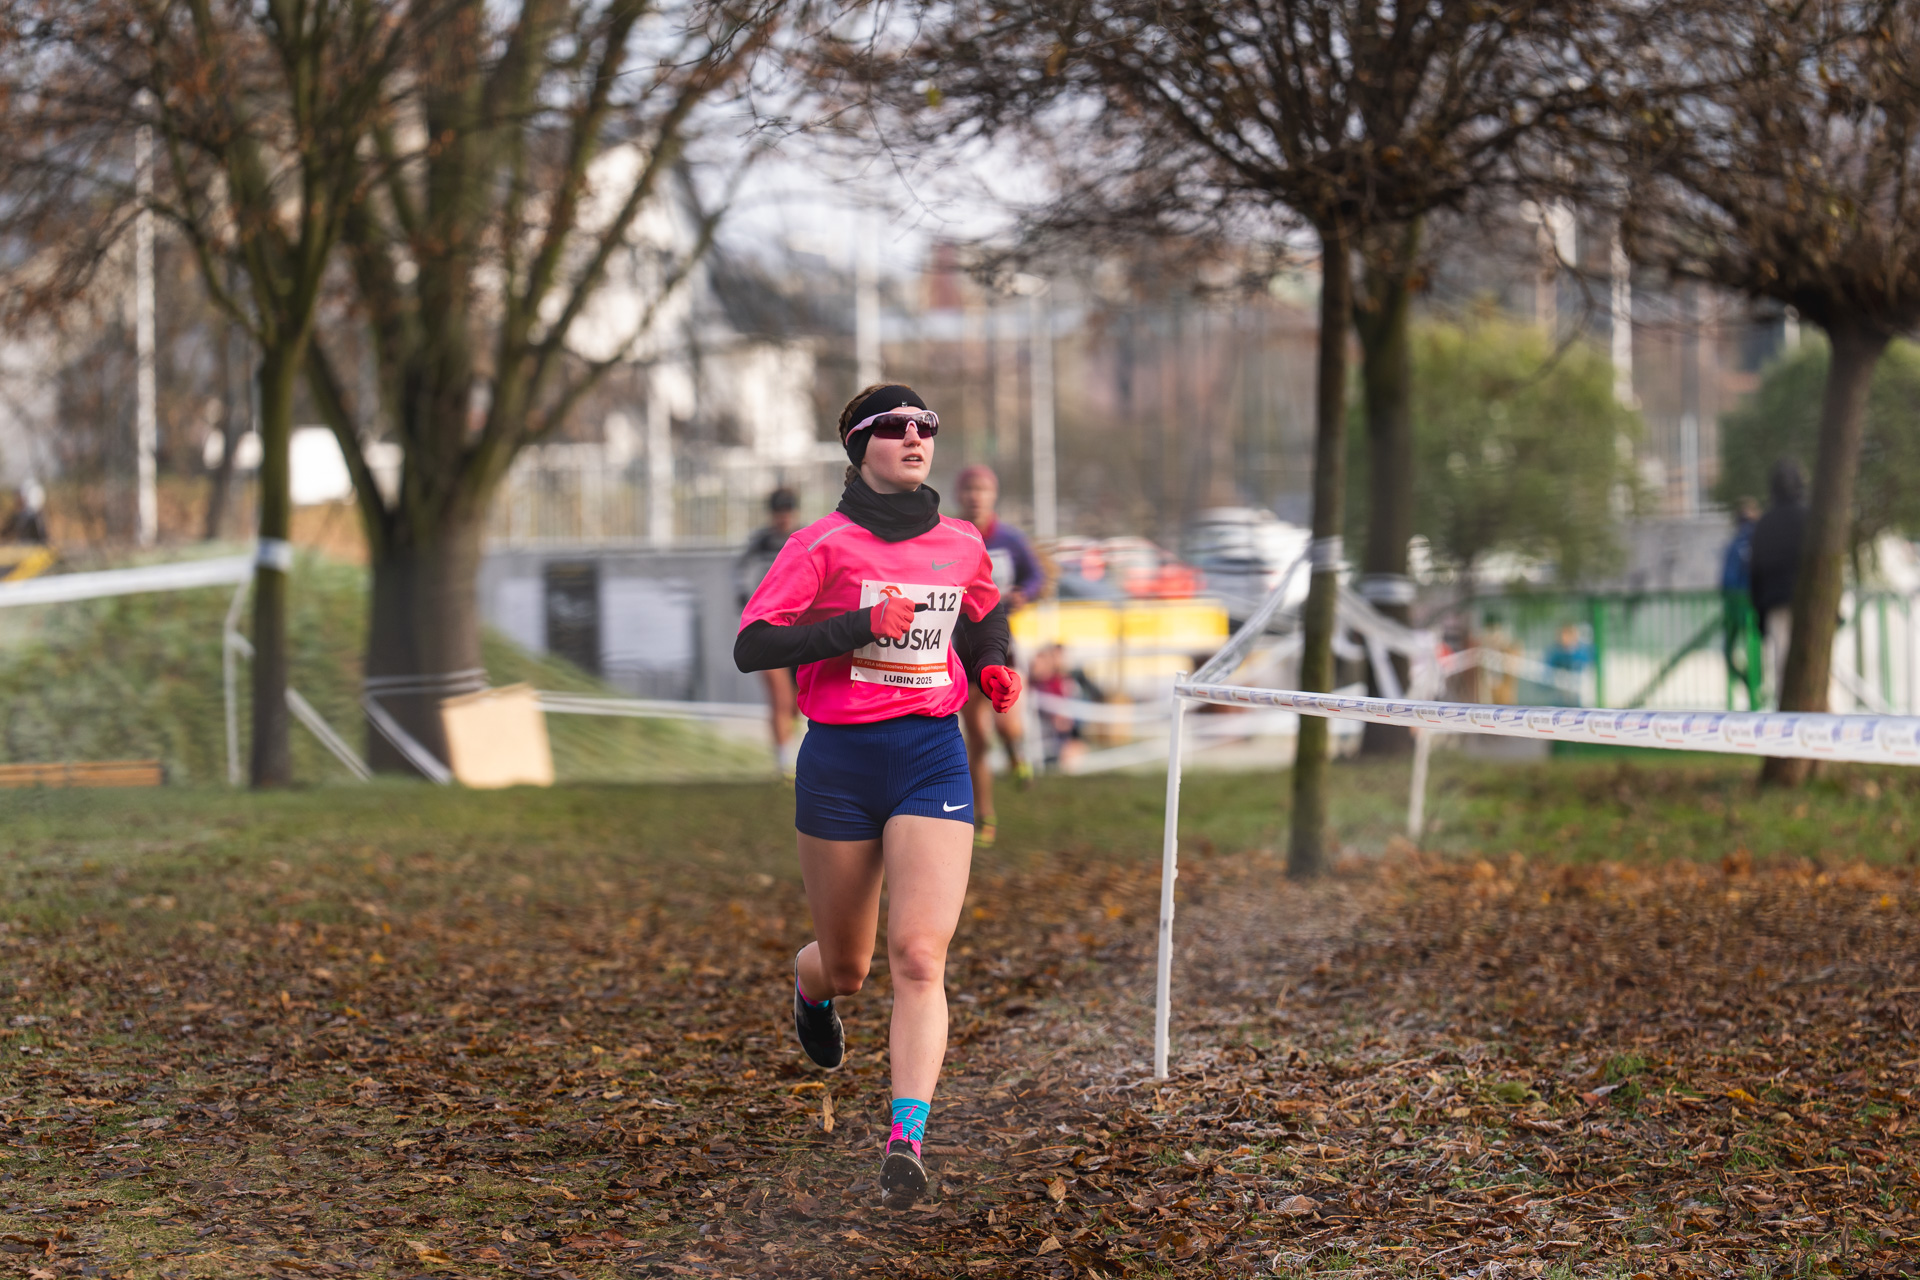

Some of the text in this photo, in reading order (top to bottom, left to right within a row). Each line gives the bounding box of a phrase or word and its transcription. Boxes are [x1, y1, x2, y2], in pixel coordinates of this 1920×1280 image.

[926, 591, 957, 612] 112
[883, 674, 932, 685] LUBIN 2025
